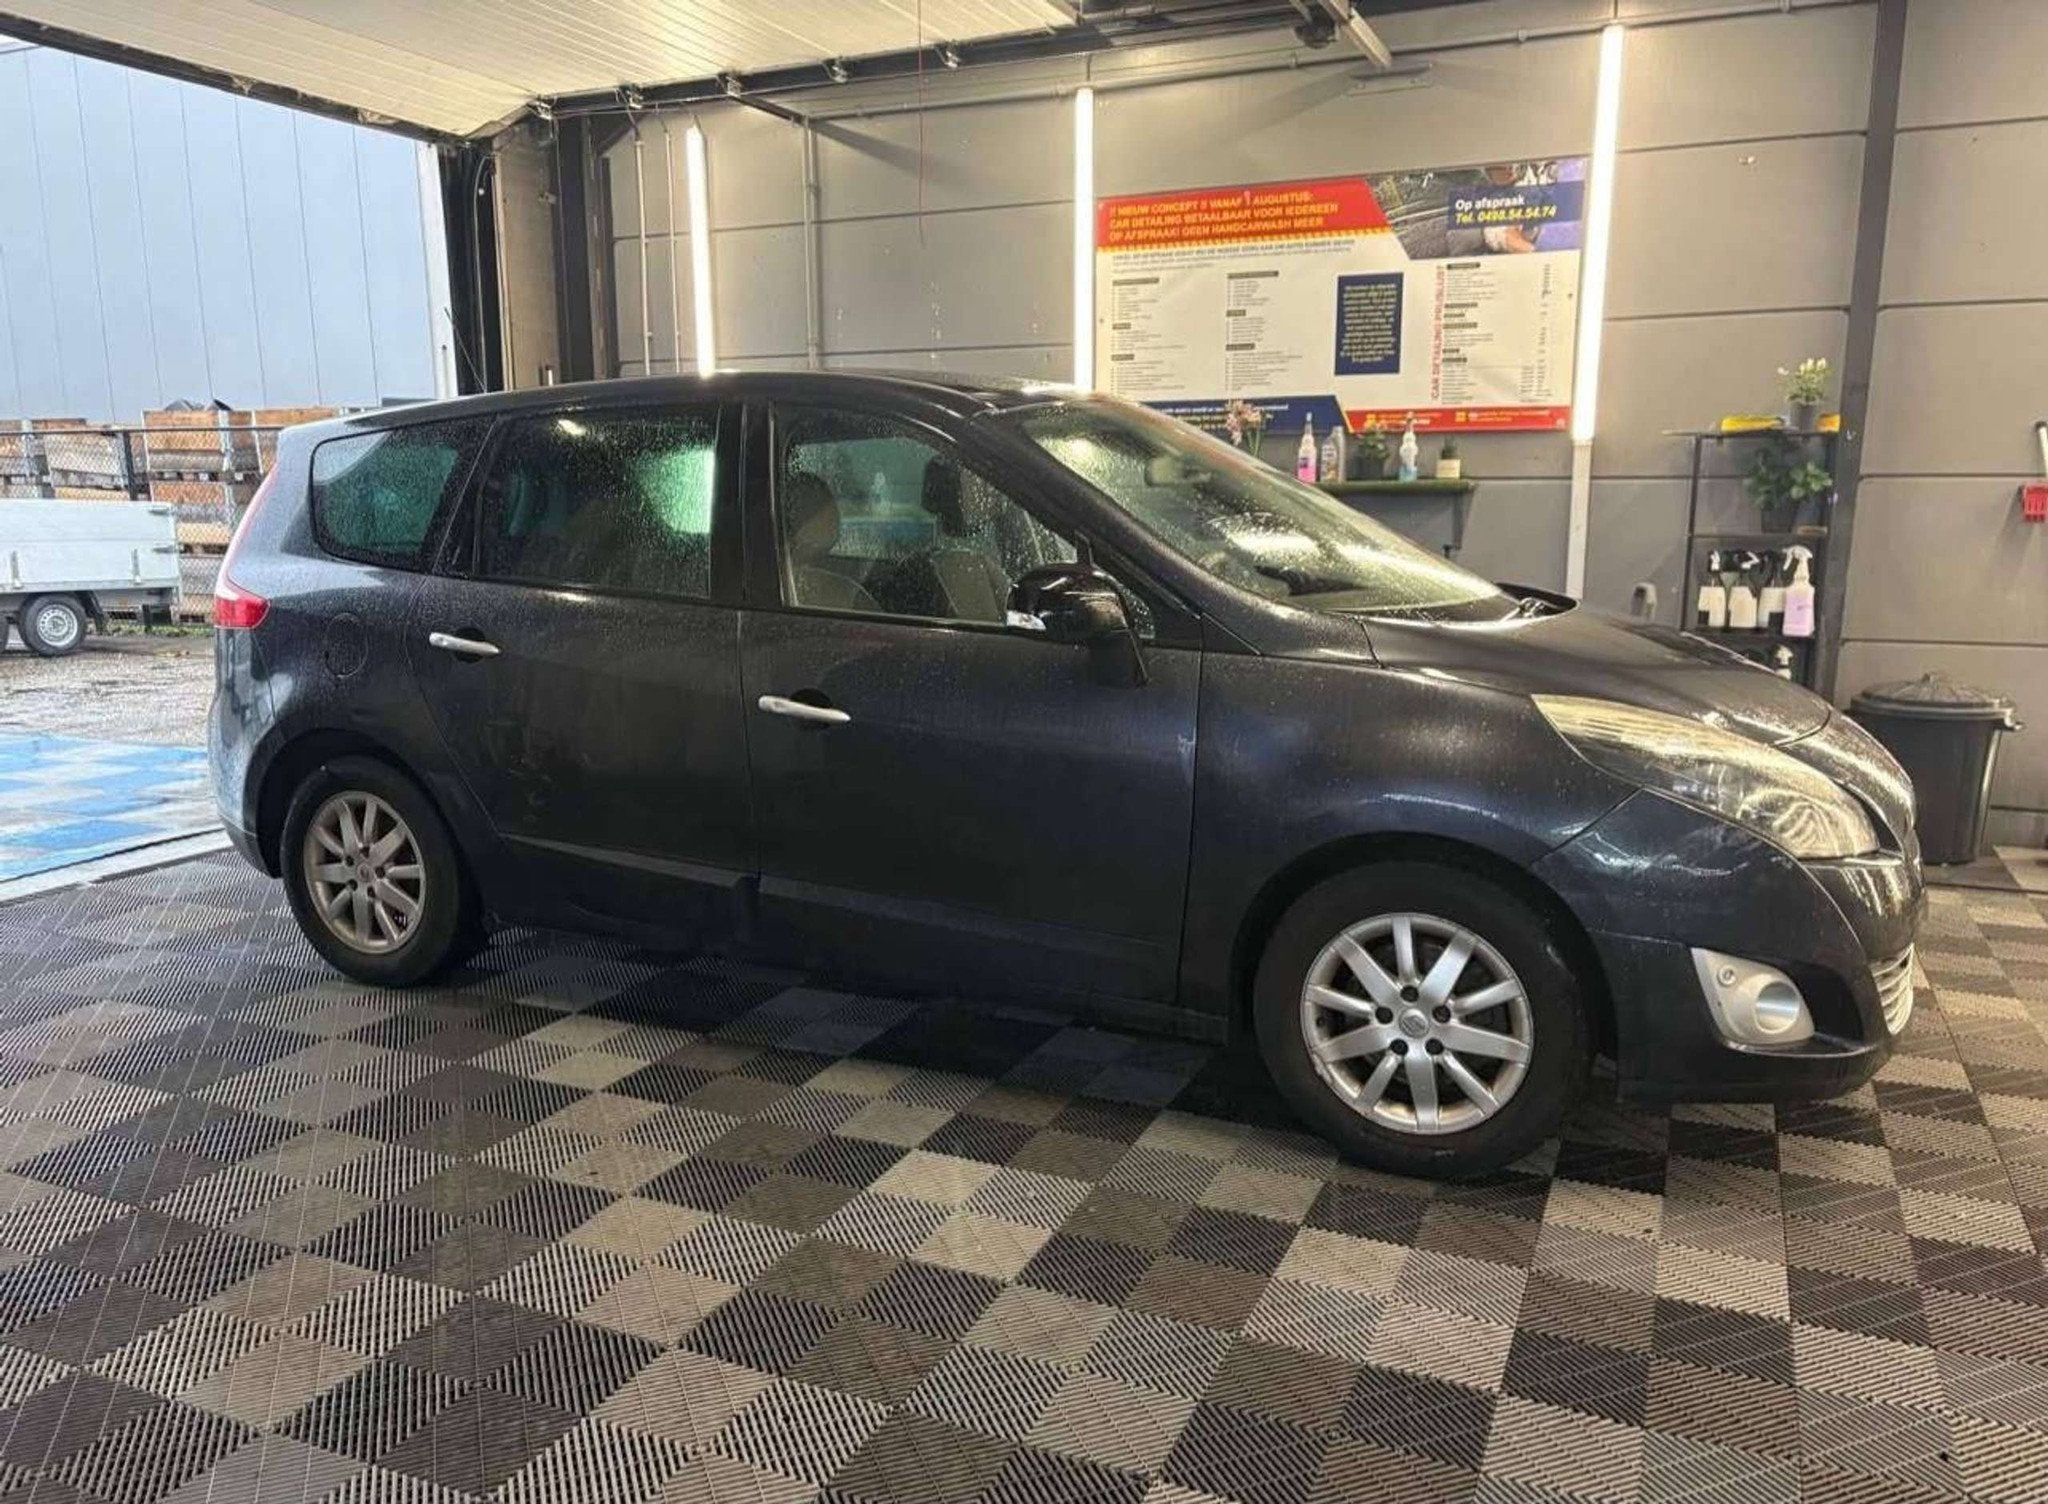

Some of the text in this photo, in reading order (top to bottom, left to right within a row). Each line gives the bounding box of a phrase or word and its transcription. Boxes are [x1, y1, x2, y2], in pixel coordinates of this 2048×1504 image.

[1150, 201, 1199, 215] CONCEPT
[1209, 197, 1242, 209] VANAF
[1455, 194, 1525, 212] Op afspraak
[1110, 217, 1129, 229] CAR
[1132, 213, 1181, 227] DETAILING
[1253, 206, 1283, 219] VOOR
[1456, 211, 1474, 223] Tel.
[1110, 230, 1122, 242] OP
[1212, 218, 1292, 234] HANDCARWASH
[1294, 216, 1324, 229] MEER
